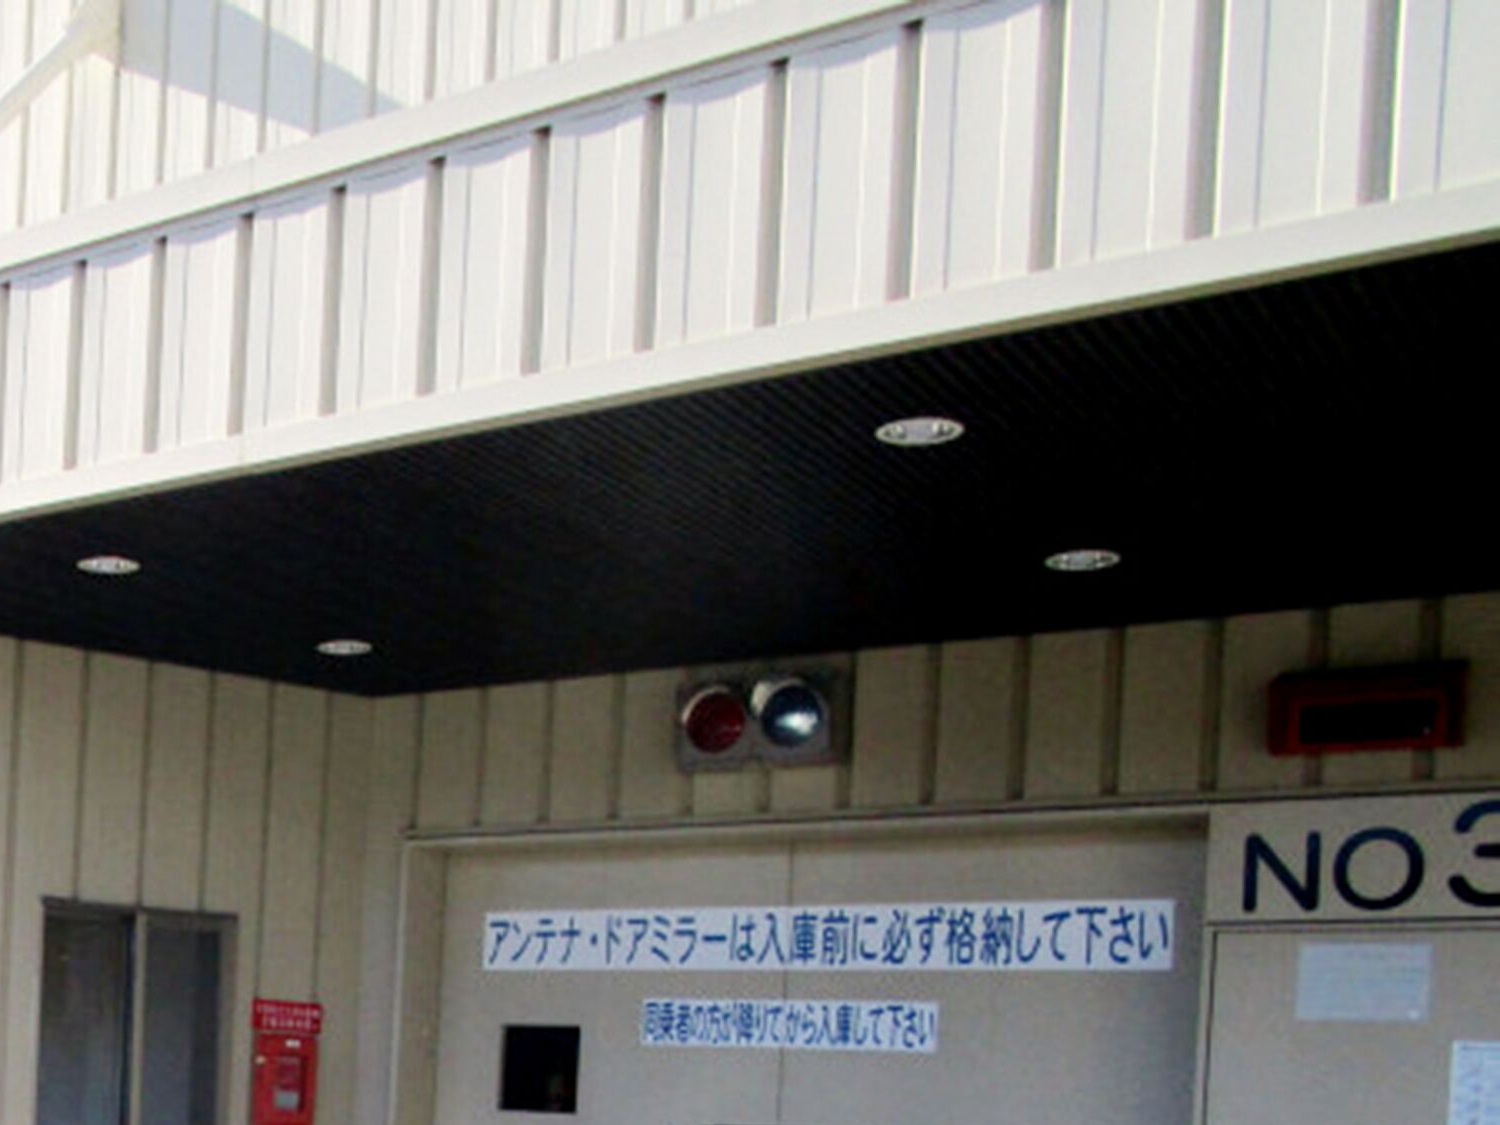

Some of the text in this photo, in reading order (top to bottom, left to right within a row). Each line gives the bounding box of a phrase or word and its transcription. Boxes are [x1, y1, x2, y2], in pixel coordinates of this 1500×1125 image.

[1242, 799, 1500, 912] NO3
[487, 906, 1169, 967] アンテナ・ドアミラーは入庫前に必ず格納して下さい
